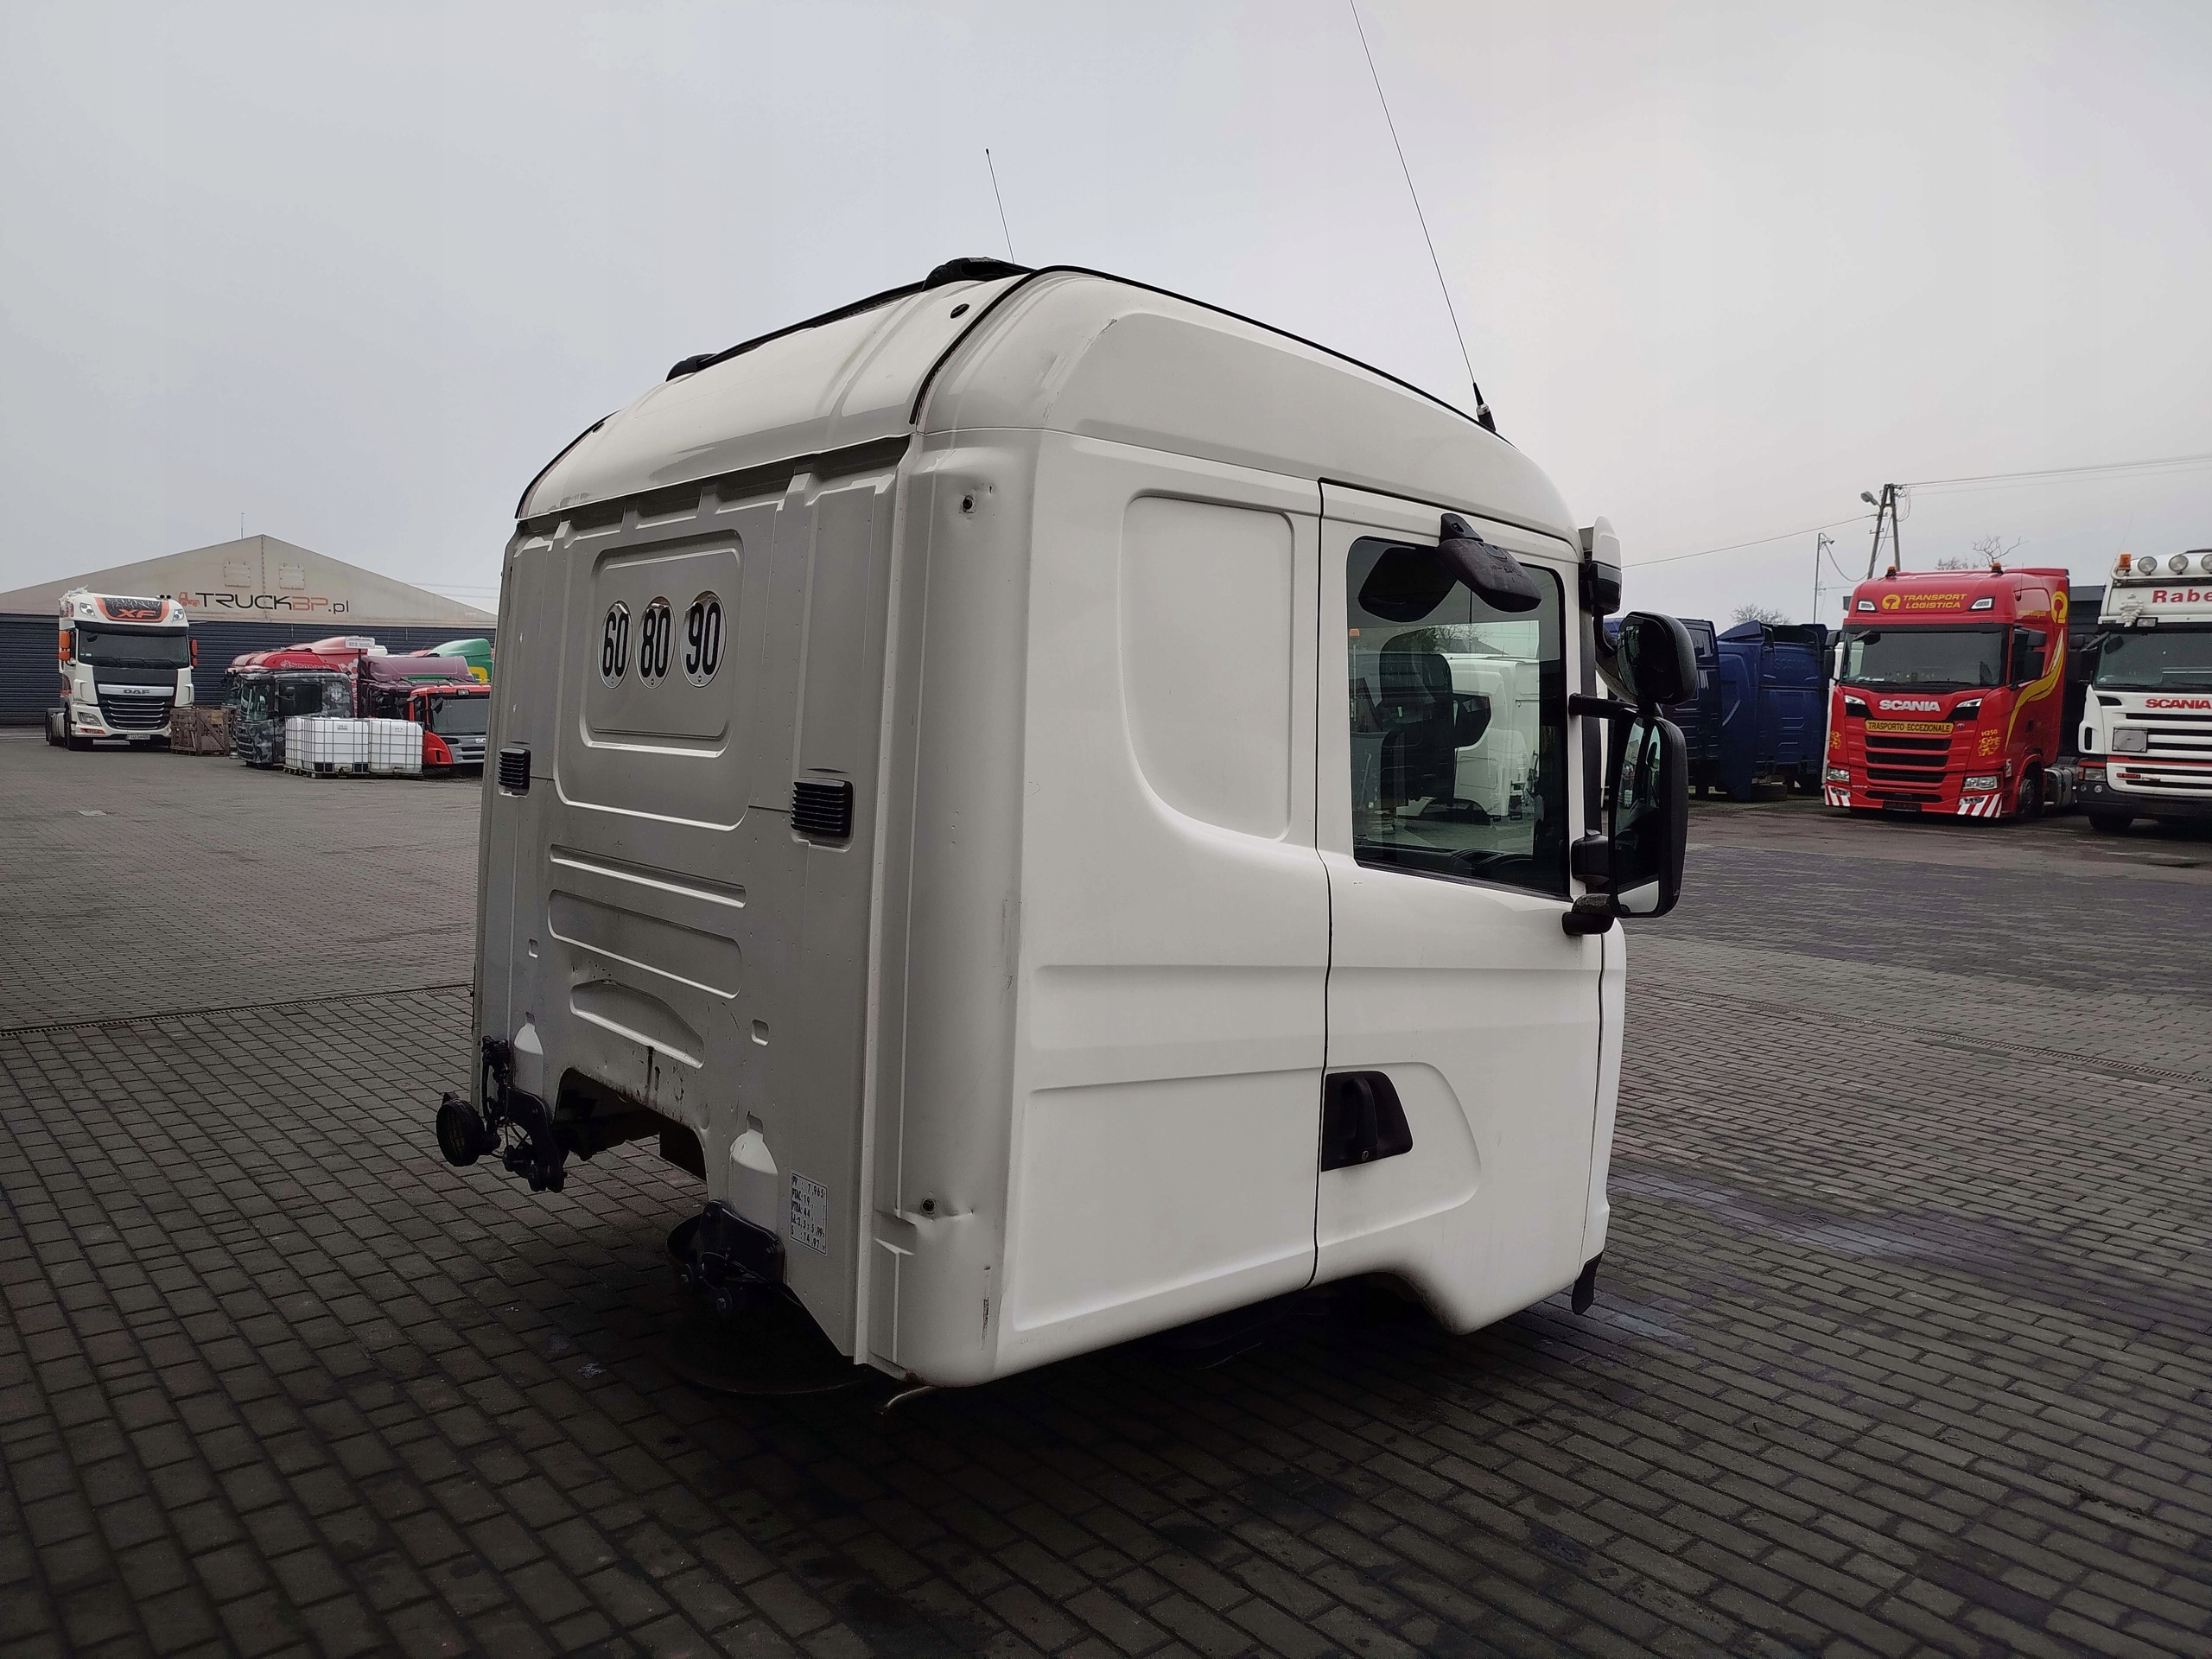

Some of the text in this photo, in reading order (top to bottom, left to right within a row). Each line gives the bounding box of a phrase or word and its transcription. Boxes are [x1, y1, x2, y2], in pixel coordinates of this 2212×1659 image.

[117, 608, 156, 619] XF
[602, 611, 629, 677] 60
[640, 606, 671, 678] 80
[686, 602, 721, 675] 90
[1879, 700, 1941, 712] SCANIA
[2145, 698, 2212, 709] SCANIA
[1868, 721, 1950, 733] TRASPORTO ECCEZIONALE
